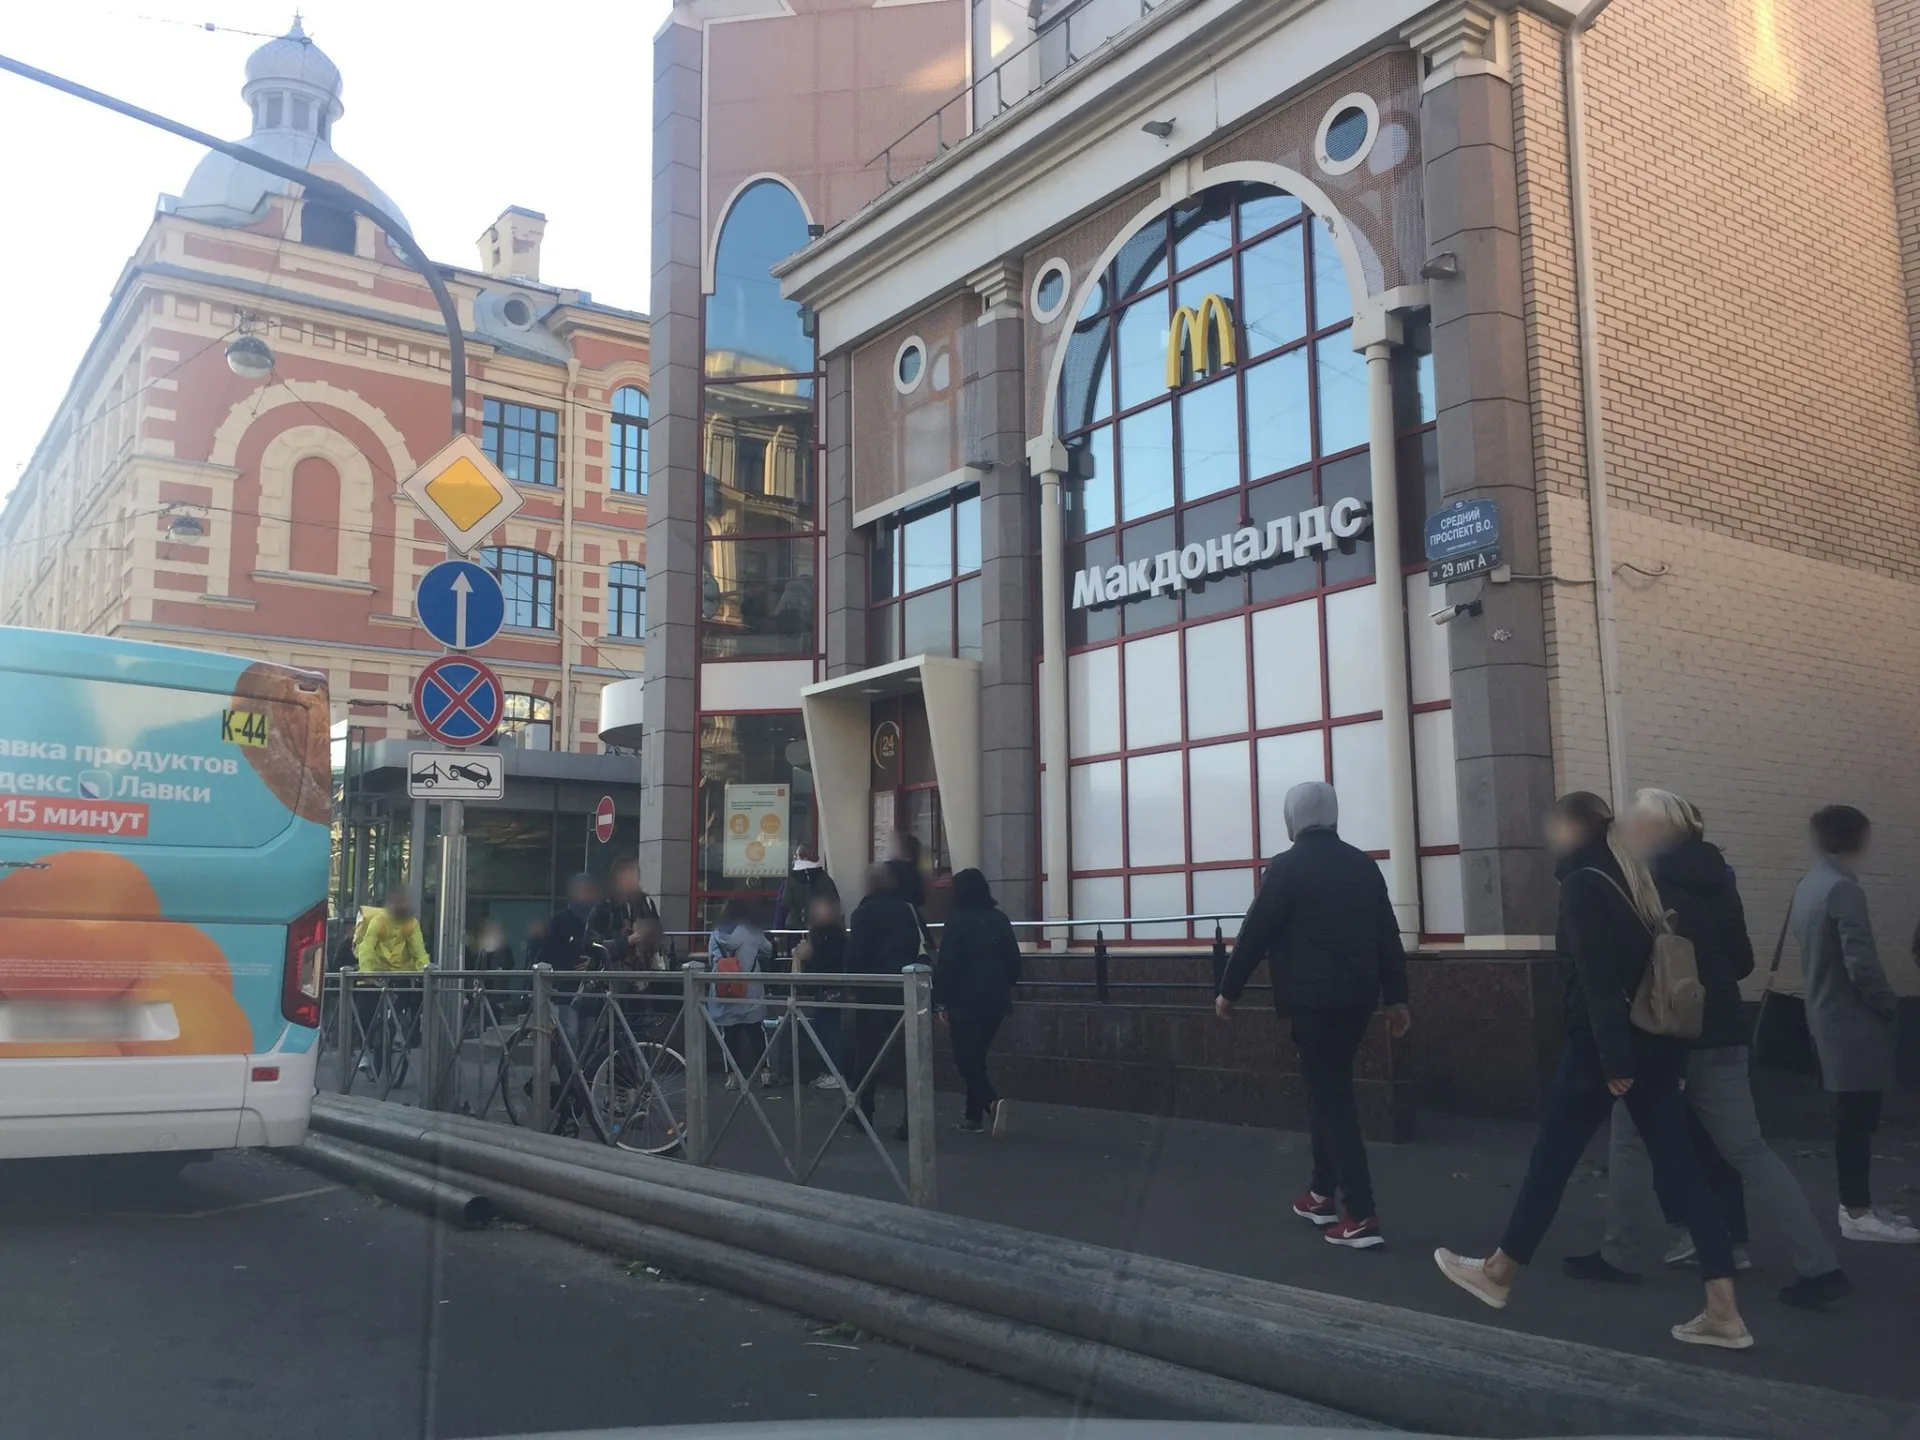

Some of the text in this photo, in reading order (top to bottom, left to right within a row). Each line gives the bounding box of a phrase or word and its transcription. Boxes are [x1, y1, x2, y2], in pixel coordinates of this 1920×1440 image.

[1429, 523, 1474, 546] ПРОСПЕКТ
[1475, 519, 1494, 533] В.О.
[1440, 507, 1480, 530] СРЕДНИЙ
[1072, 497, 1372, 609] Макдоналдс
[1441, 562, 1454, 578] 29
[1478, 553, 1487, 568] А
[221, 709, 266, 745] К-44
[882, 735, 894, 750] 24
[75, 744, 238, 775] продуктов
[117, 775, 211, 803] Лавки
[0, 799, 144, 834] 15 минут
